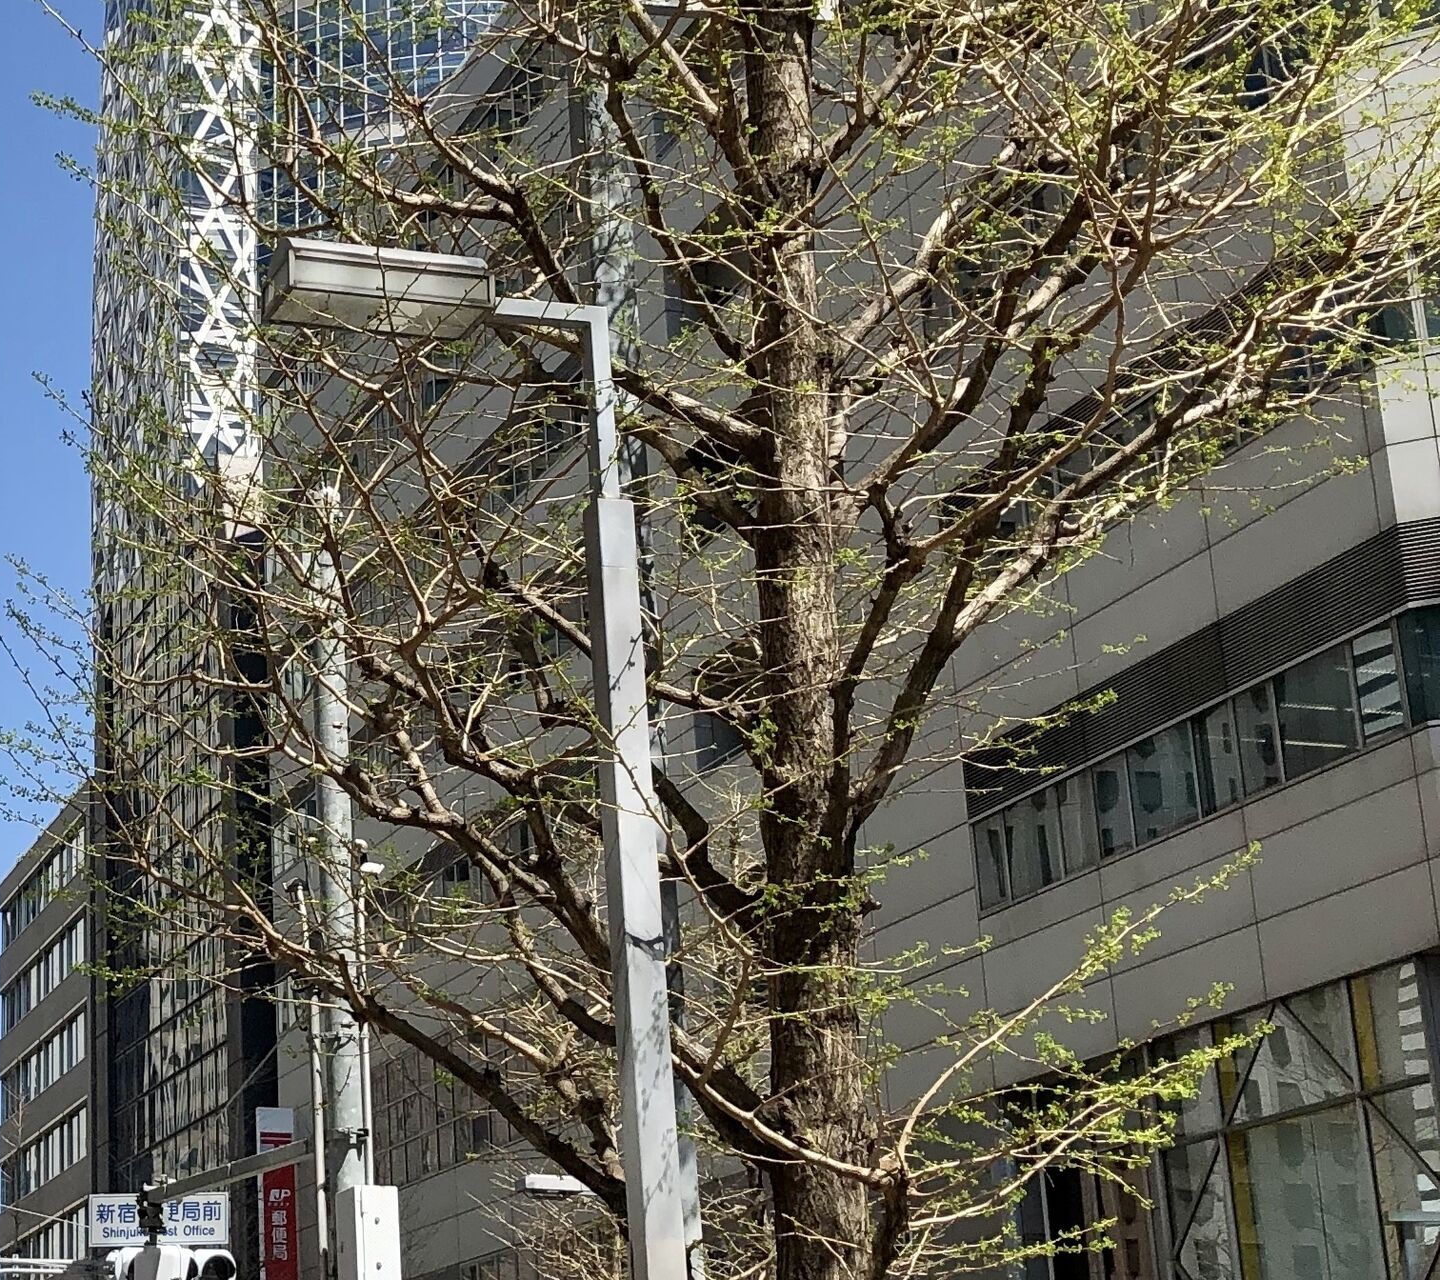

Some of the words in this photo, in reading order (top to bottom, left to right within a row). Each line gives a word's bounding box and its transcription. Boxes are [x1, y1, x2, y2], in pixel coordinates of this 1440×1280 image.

[183, 1225, 216, 1236] Office
[271, 1210, 288, 1261] 郵便局
